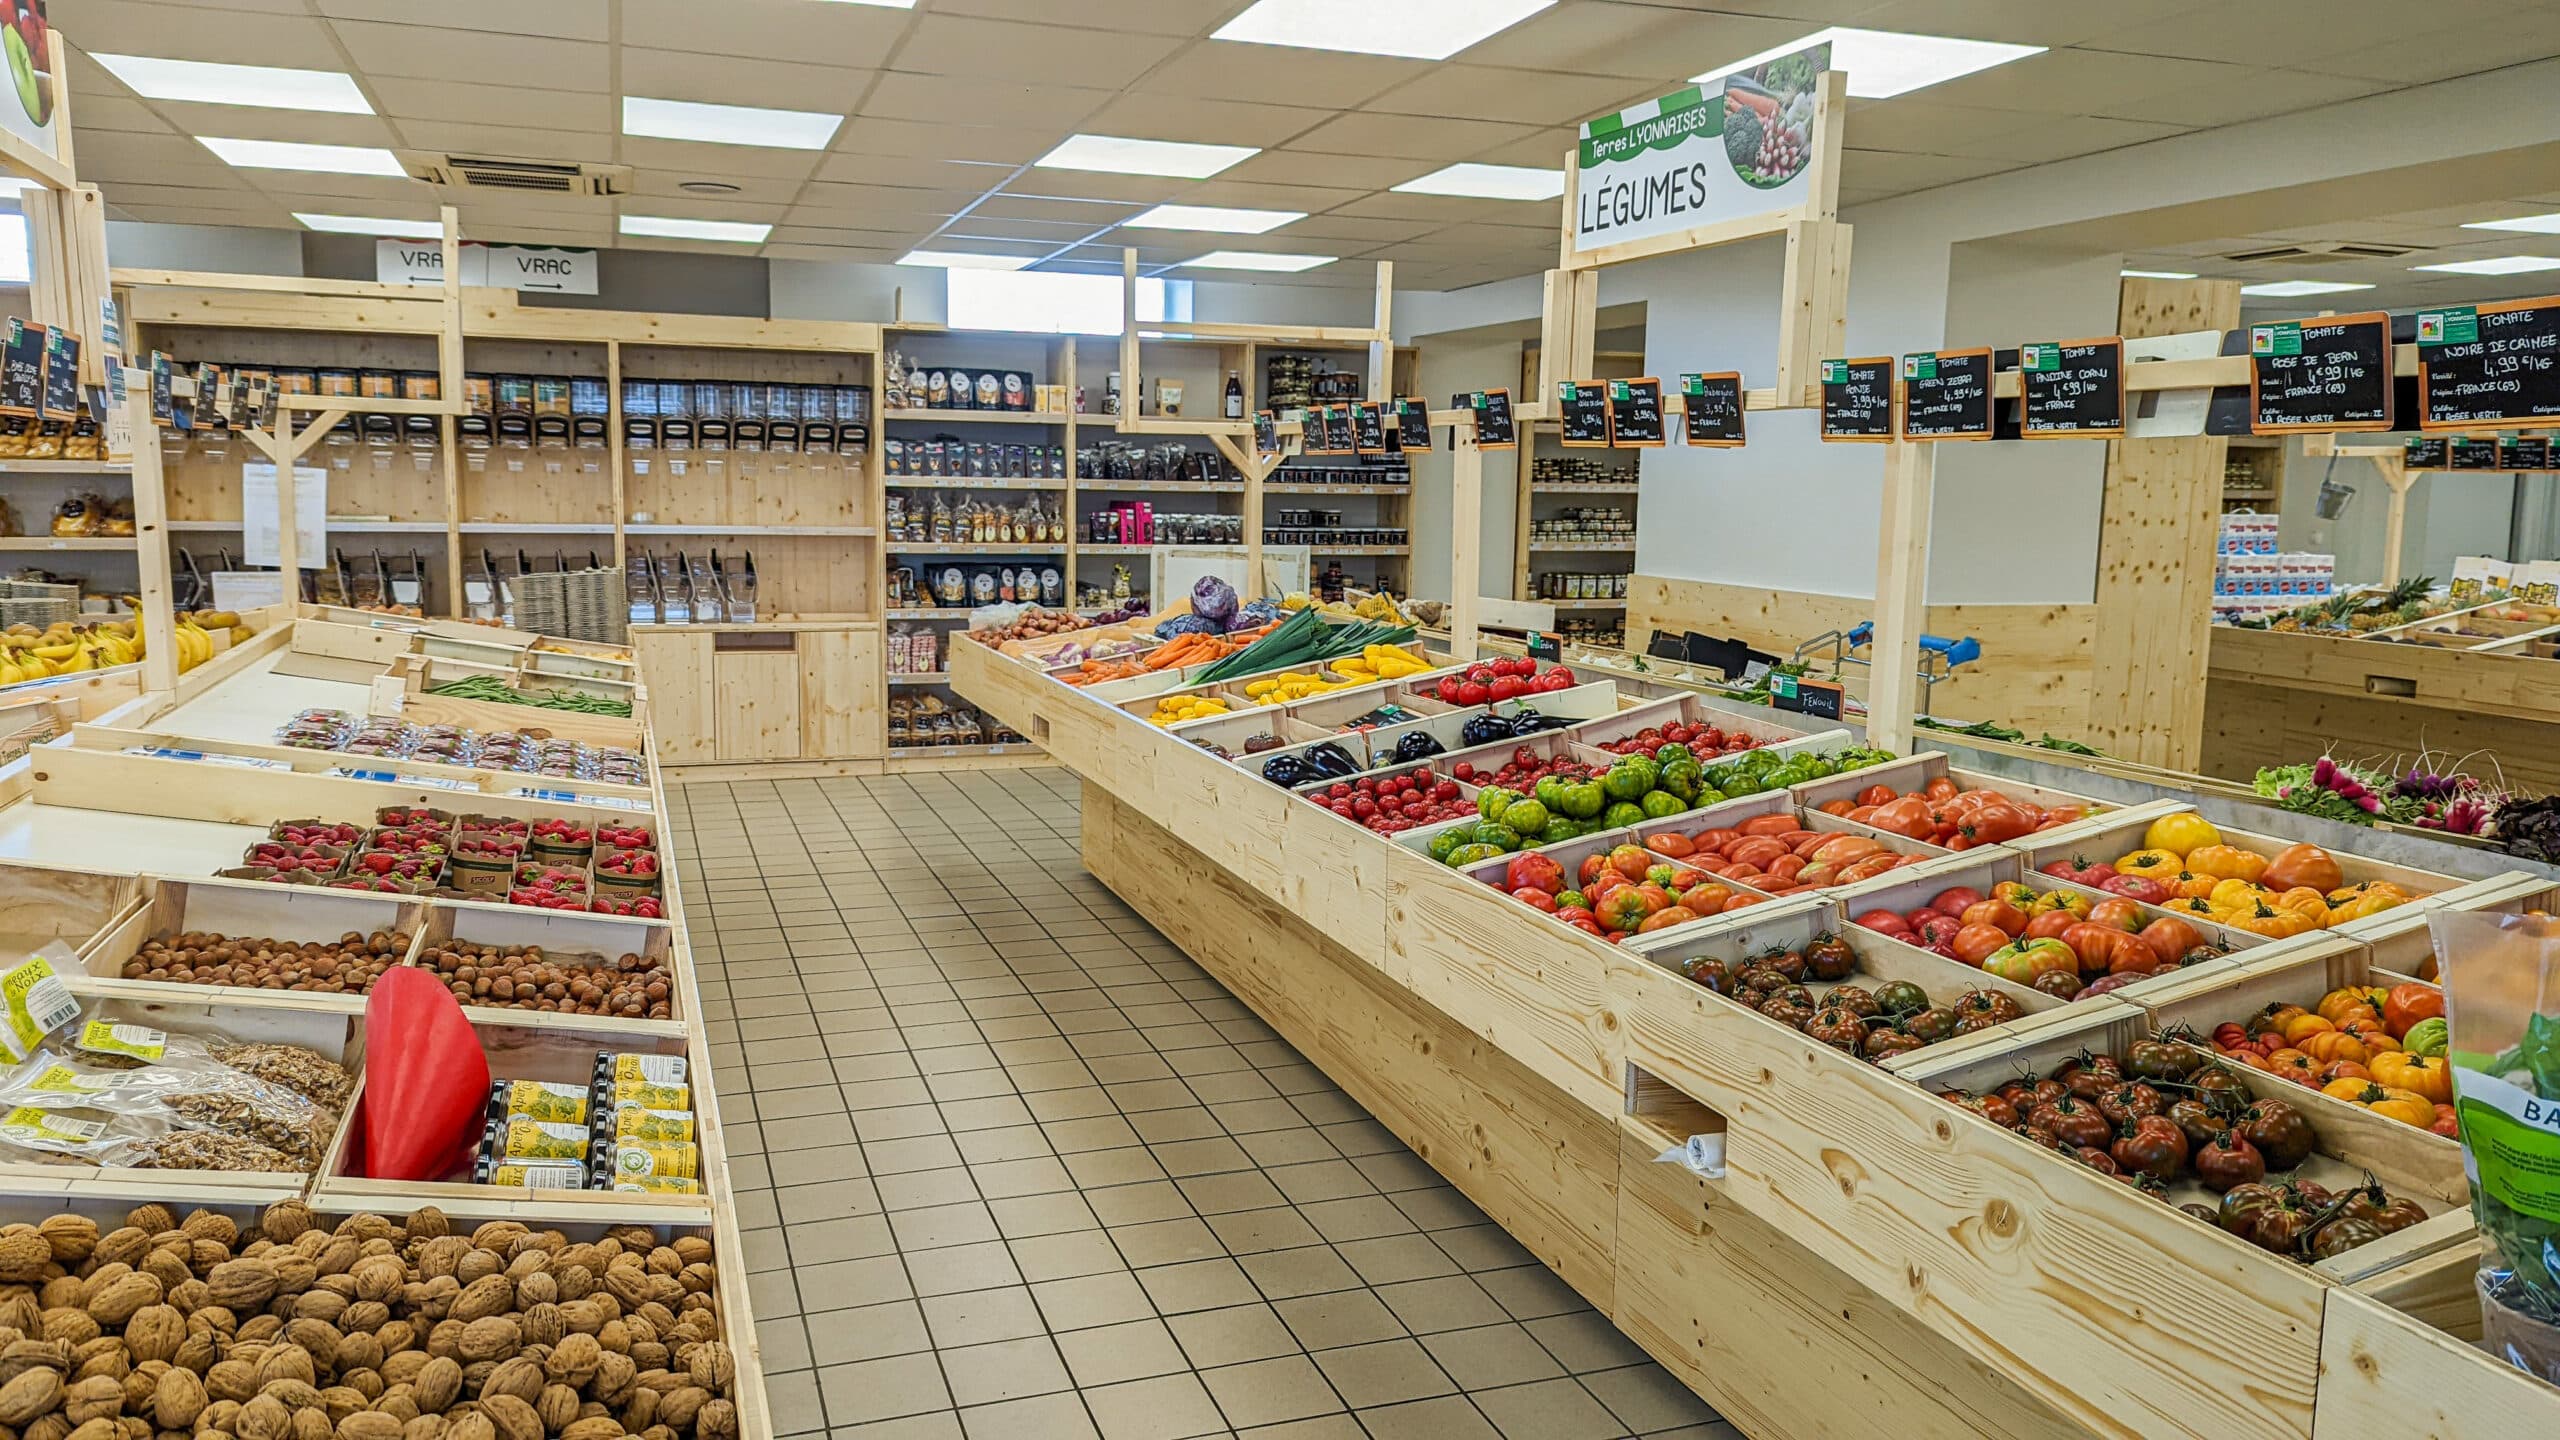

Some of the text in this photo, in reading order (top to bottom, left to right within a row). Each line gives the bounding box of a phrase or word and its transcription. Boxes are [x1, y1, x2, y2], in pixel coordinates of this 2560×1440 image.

[1591, 107, 1707, 160] Terres LYONNAISES
[1580, 162, 1707, 234] LÉGUMES
[400, 251, 443, 267] VRA
[517, 257, 572, 276] VRAC
[2481, 310, 2534, 327] TOMATE
[2302, 326, 2346, 340] TOMATE
[2061, 346, 2095, 359] TOMATE
[2444, 343, 2484, 358] NOIRE
[2488, 340, 2506, 353] DE
[1939, 357, 1969, 368] TOMATE
[2302, 356, 2318, 366] DE
[2324, 351, 2358, 364] BERN
[1919, 378, 1944, 389] GREEN
[2456, 382, 2496, 395] FRANCE
[2285, 385, 2322, 399] FRANCE
